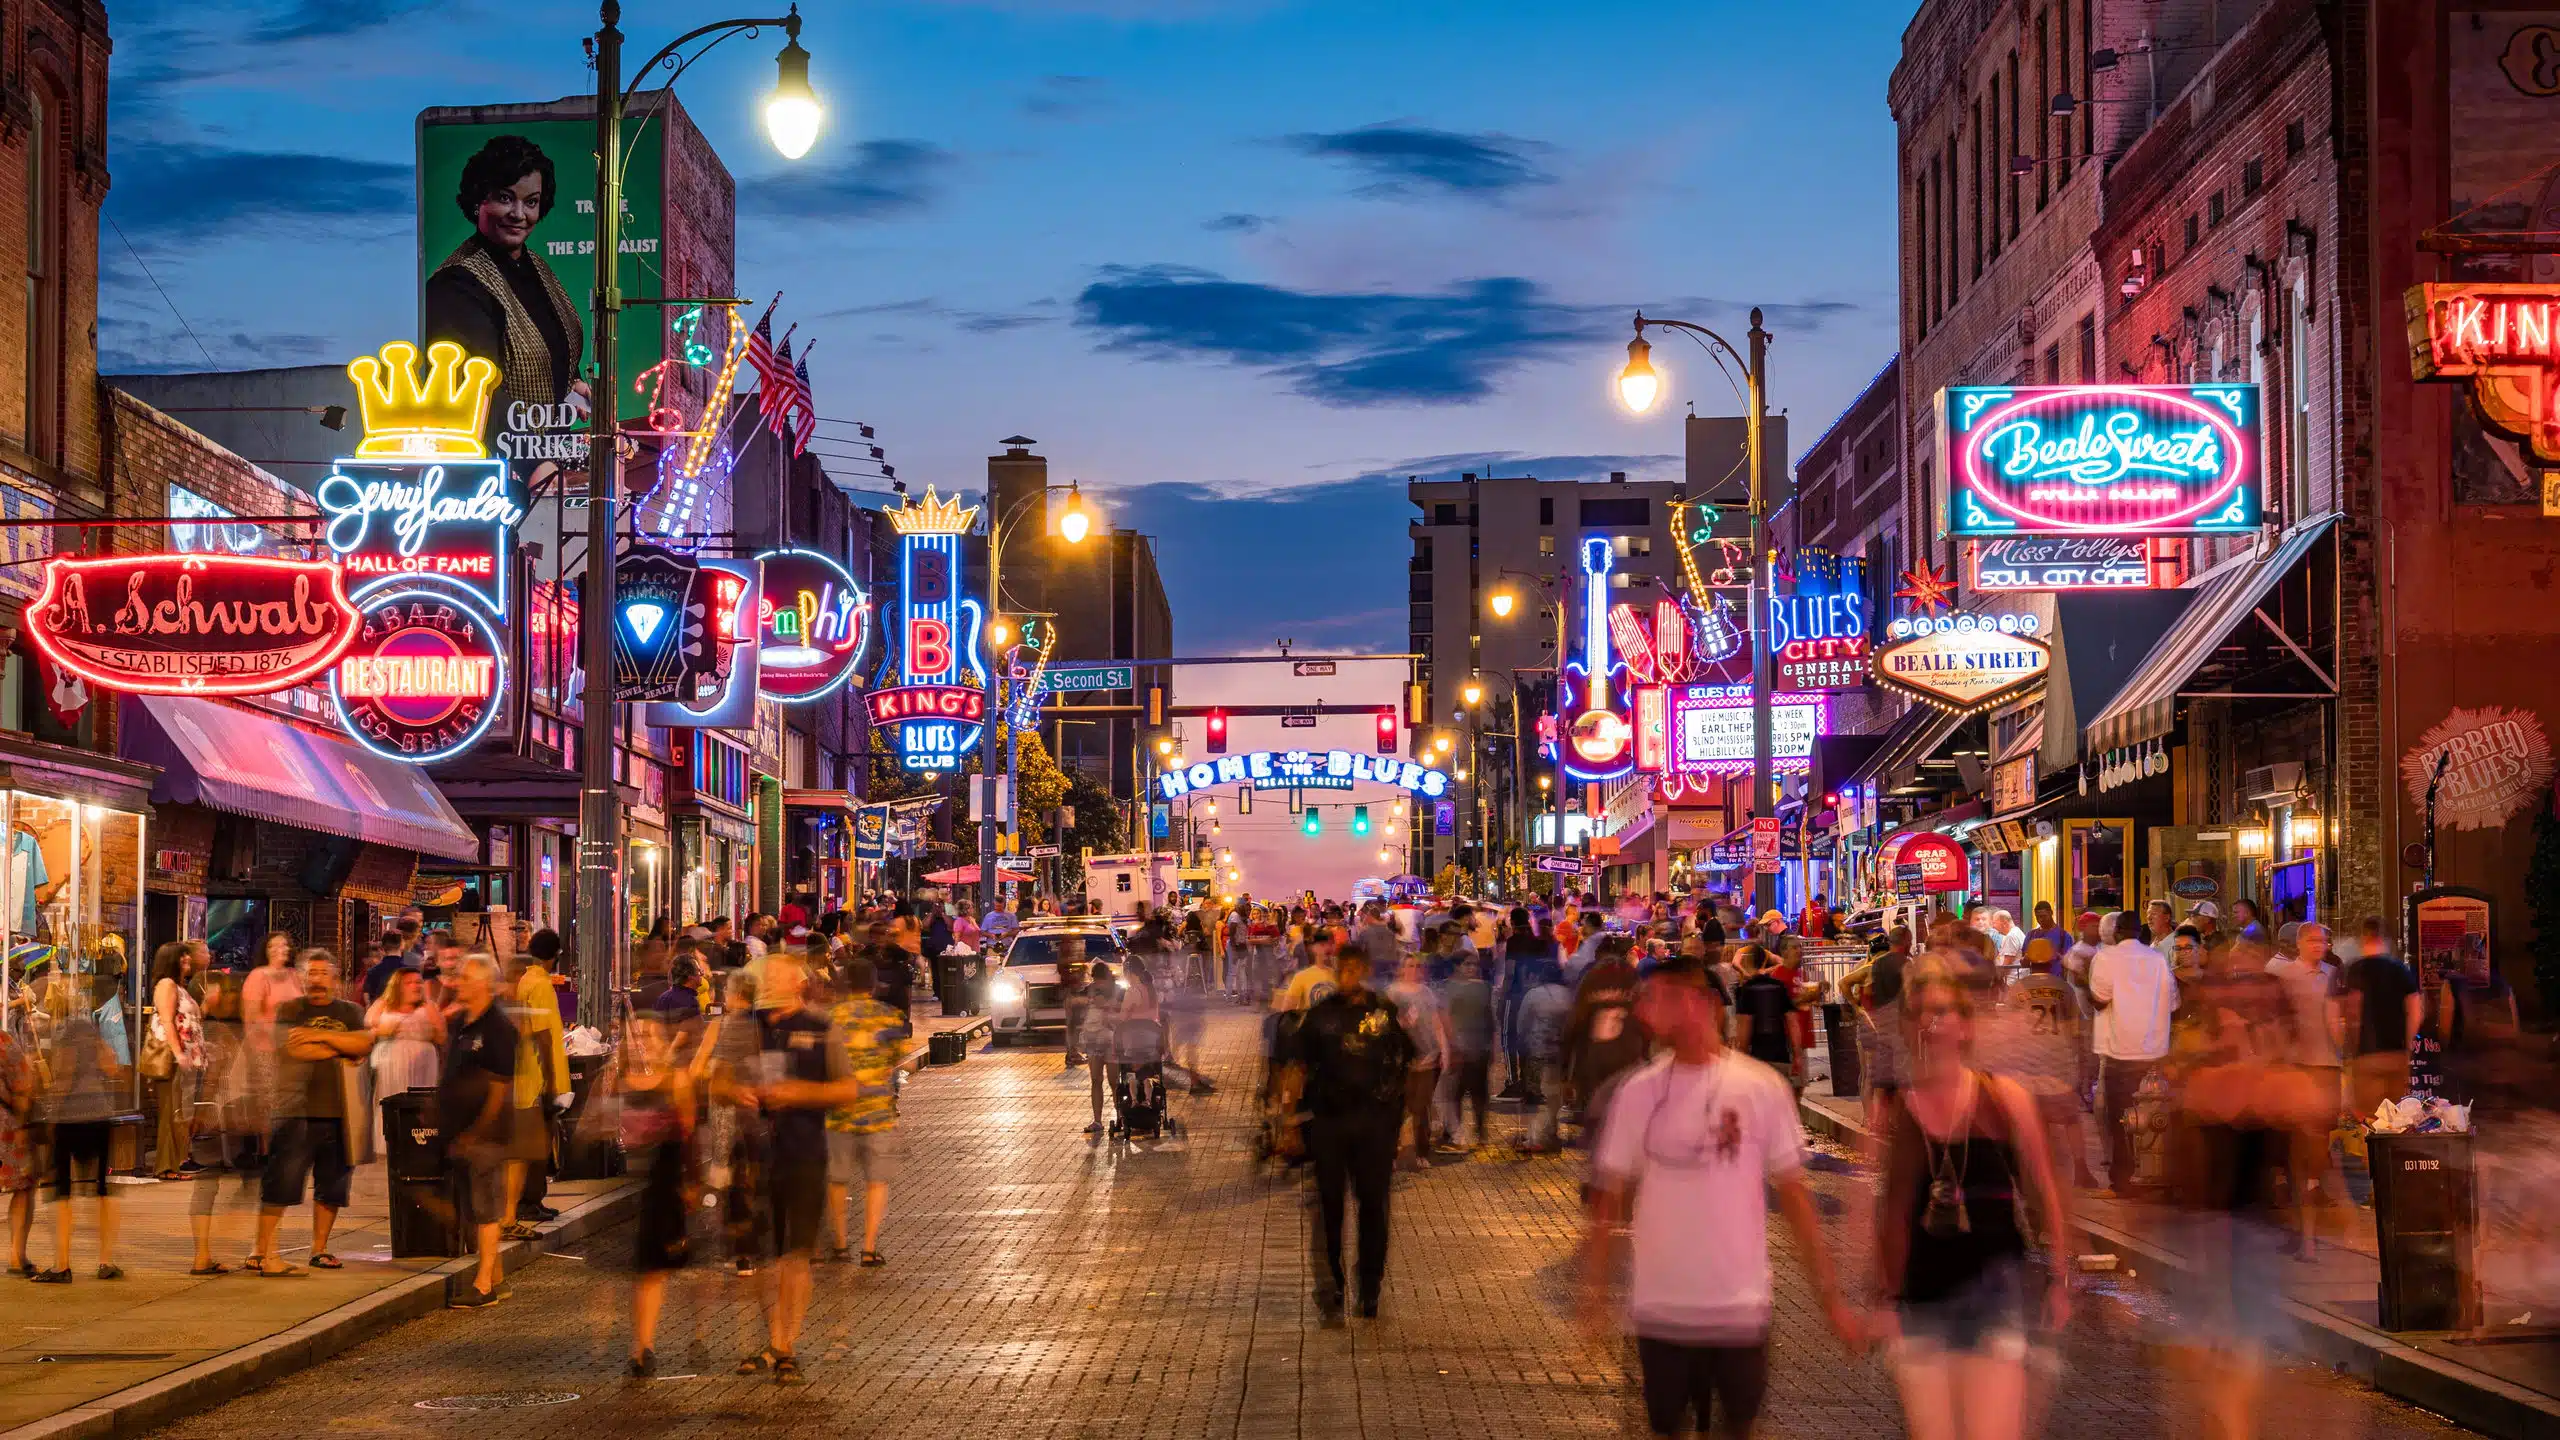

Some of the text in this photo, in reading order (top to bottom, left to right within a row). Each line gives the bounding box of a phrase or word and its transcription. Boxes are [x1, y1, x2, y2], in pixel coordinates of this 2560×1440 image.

[547, 239, 658, 255] THE SPALIST
[2452, 299, 2560, 355] KIN
[507, 400, 578, 432] GOLD
[496, 431, 584, 460] STRIKE
[318, 475, 423, 553] Jerry
[399, 465, 522, 557] Lawler
[1978, 538, 2052, 563] Miss
[347, 556, 491, 572] HALL OF FAME
[911, 550, 948, 604] B
[1980, 569, 2147, 587] SOUL CITY CAFE
[114, 570, 334, 635] Schwab
[380, 602, 456, 631] BAR
[760, 582, 871, 651] emphis
[1770, 592, 1861, 653] BLUES
[909, 617, 952, 677] B
[1785, 638, 1864, 660] CITY
[100, 650, 293, 675] ESTABLISHED 1876
[1783, 660, 1864, 676] GENERAL
[1893, 650, 2041, 672] BEALE STREET
[341, 656, 494, 698] RESTAURANT
[1053, 672, 1104, 689] Second
[1106, 670, 1127, 687] St.
[1797, 674, 1851, 688] STORE
[644, 683, 675, 699] BEALE
[1688, 686, 1752, 698] BLUES CITY
[1701, 712, 1716, 722] LIVE
[1777, 710, 1782, 719] A
[1785, 709, 1804, 719] WEEK
[349, 703, 392, 741] 159
[401, 702, 484, 753] BEALE
[906, 724, 955, 752] BLUES
[1702, 724, 1726, 733] EARL
[1693, 732, 1811, 746] BLIND MISSISSIPP RRIS 5PM
[2420, 720, 2529, 780] BURRITO
[906, 755, 955, 768] CLUB
[1699, 746, 1736, 757] HILLBILLY
[1160, 750, 1448, 799] HOME OF THE BLUES
[1260, 776, 1347, 788] BEALE STREET
[2444, 750, 2521, 798] BLUES
[2456, 779, 2524, 812] MEXICAN GRILL
[1759, 820, 1775, 830] NO
[1015, 860, 1028, 868] WAY
[1915, 849, 1948, 858] GRAB
[2405, 1160, 2440, 1171] 03170192
